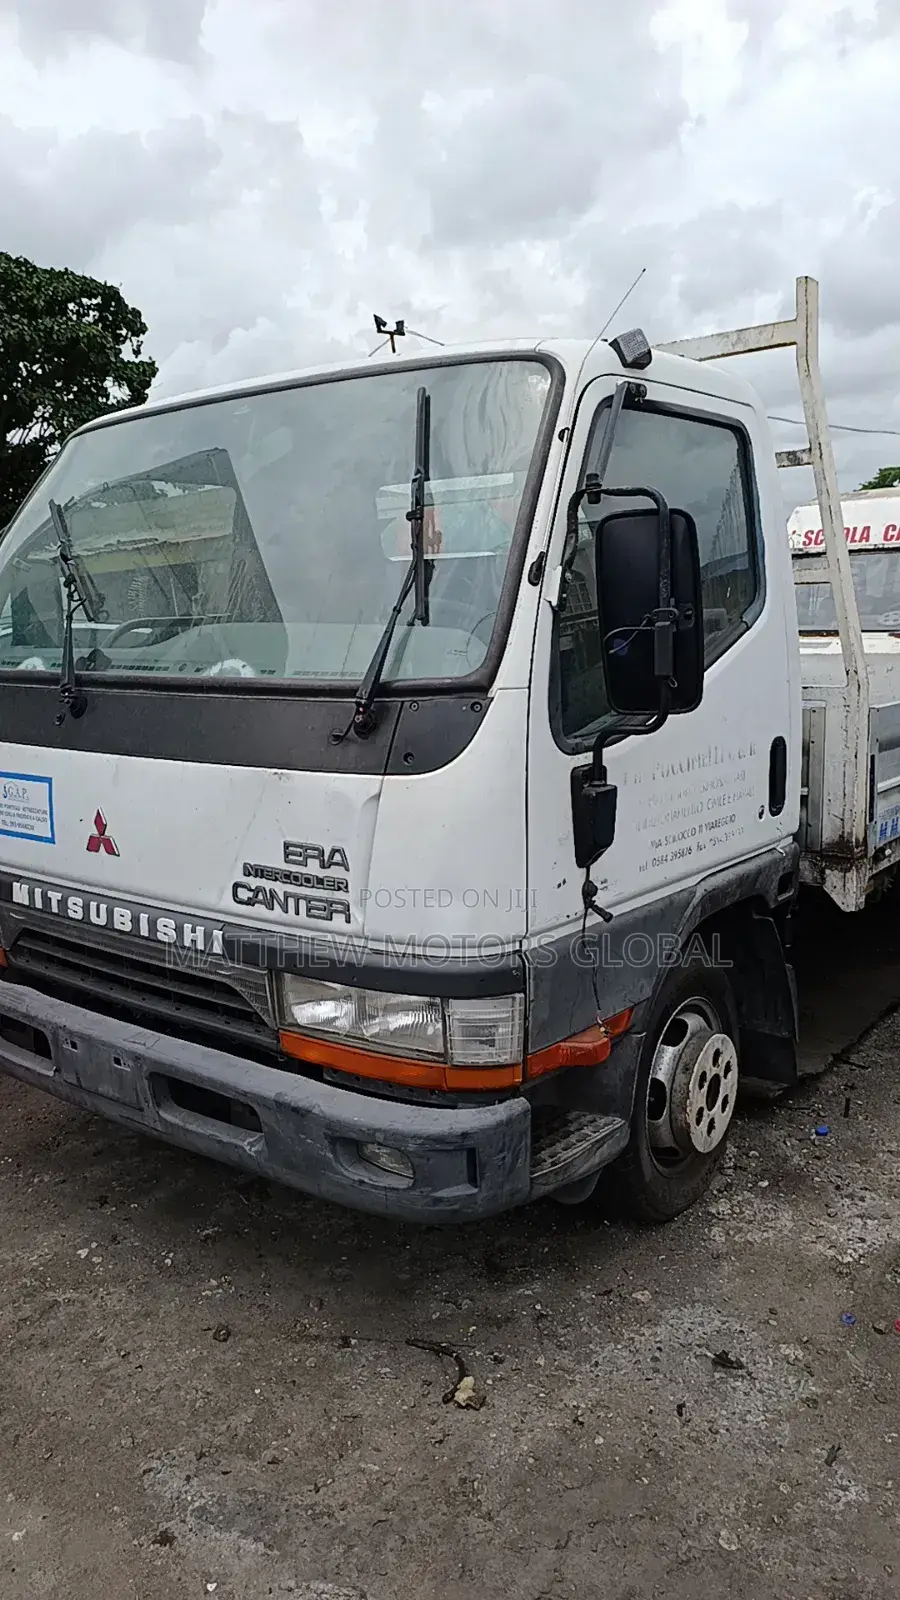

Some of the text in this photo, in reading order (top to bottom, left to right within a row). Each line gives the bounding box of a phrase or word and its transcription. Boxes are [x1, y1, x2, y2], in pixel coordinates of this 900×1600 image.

[283, 839, 350, 872] ERA
[12, 881, 224, 956] MITSUBISHI
[232, 881, 351, 924] CANTER
